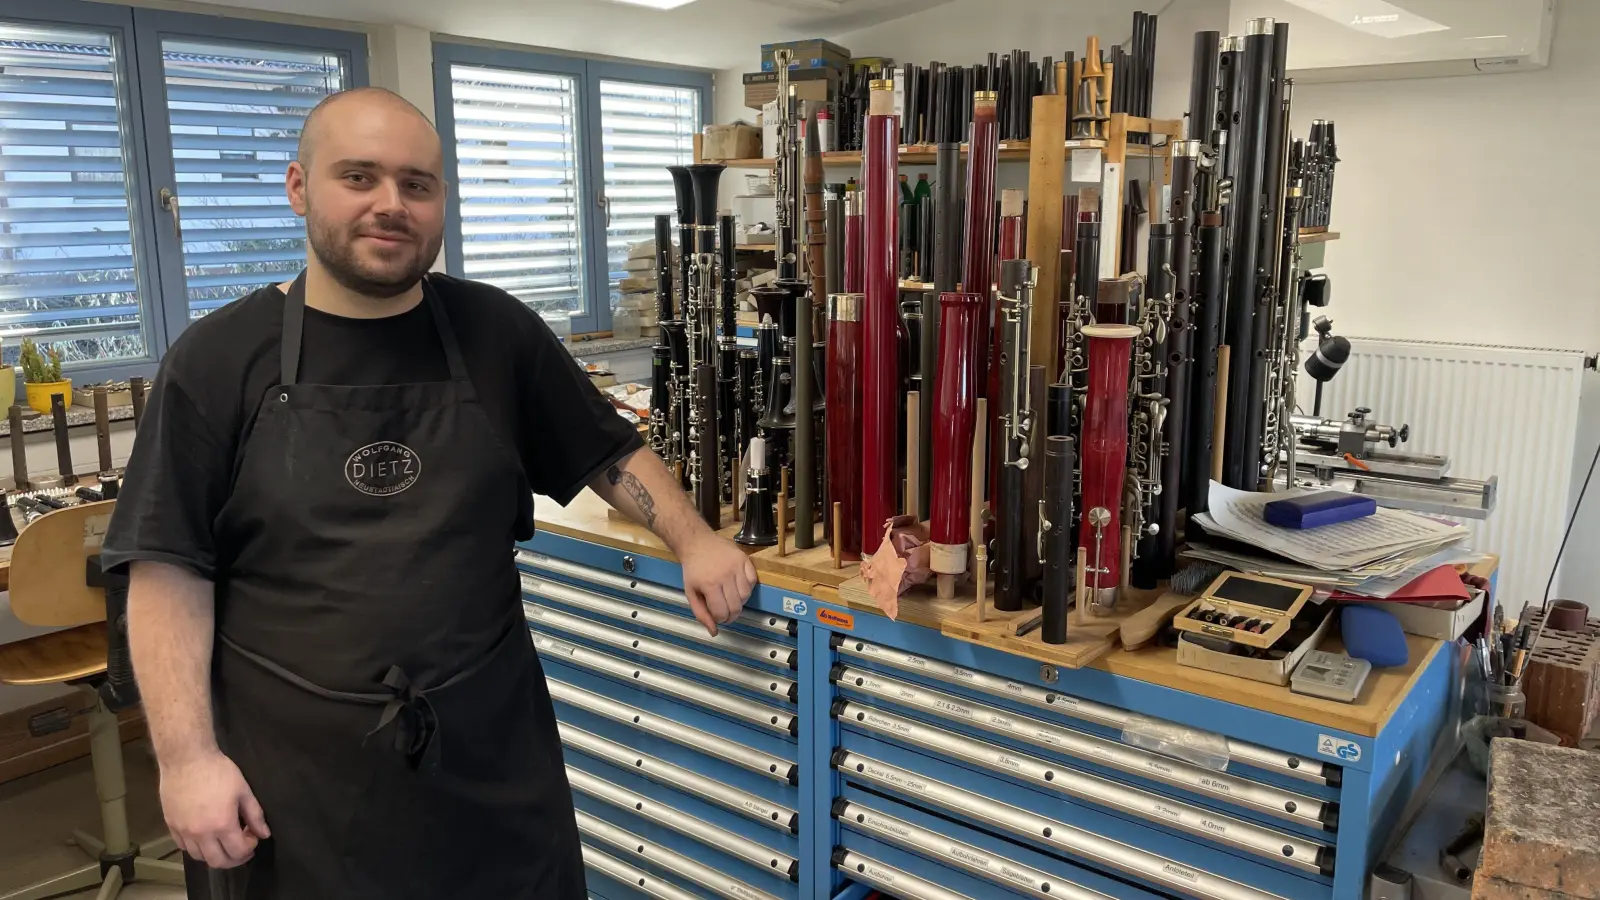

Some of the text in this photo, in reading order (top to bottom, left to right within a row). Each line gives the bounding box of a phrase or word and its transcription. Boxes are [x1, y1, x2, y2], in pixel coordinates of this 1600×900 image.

[352, 445, 411, 462] WOLFGANG
[353, 459, 414, 478] DIETZ
[794, 601, 806, 614] GS
[1007, 683, 1022, 692] 4mm
[1336, 743, 1359, 759] GS
[1201, 778, 1230, 791] ab 6mm
